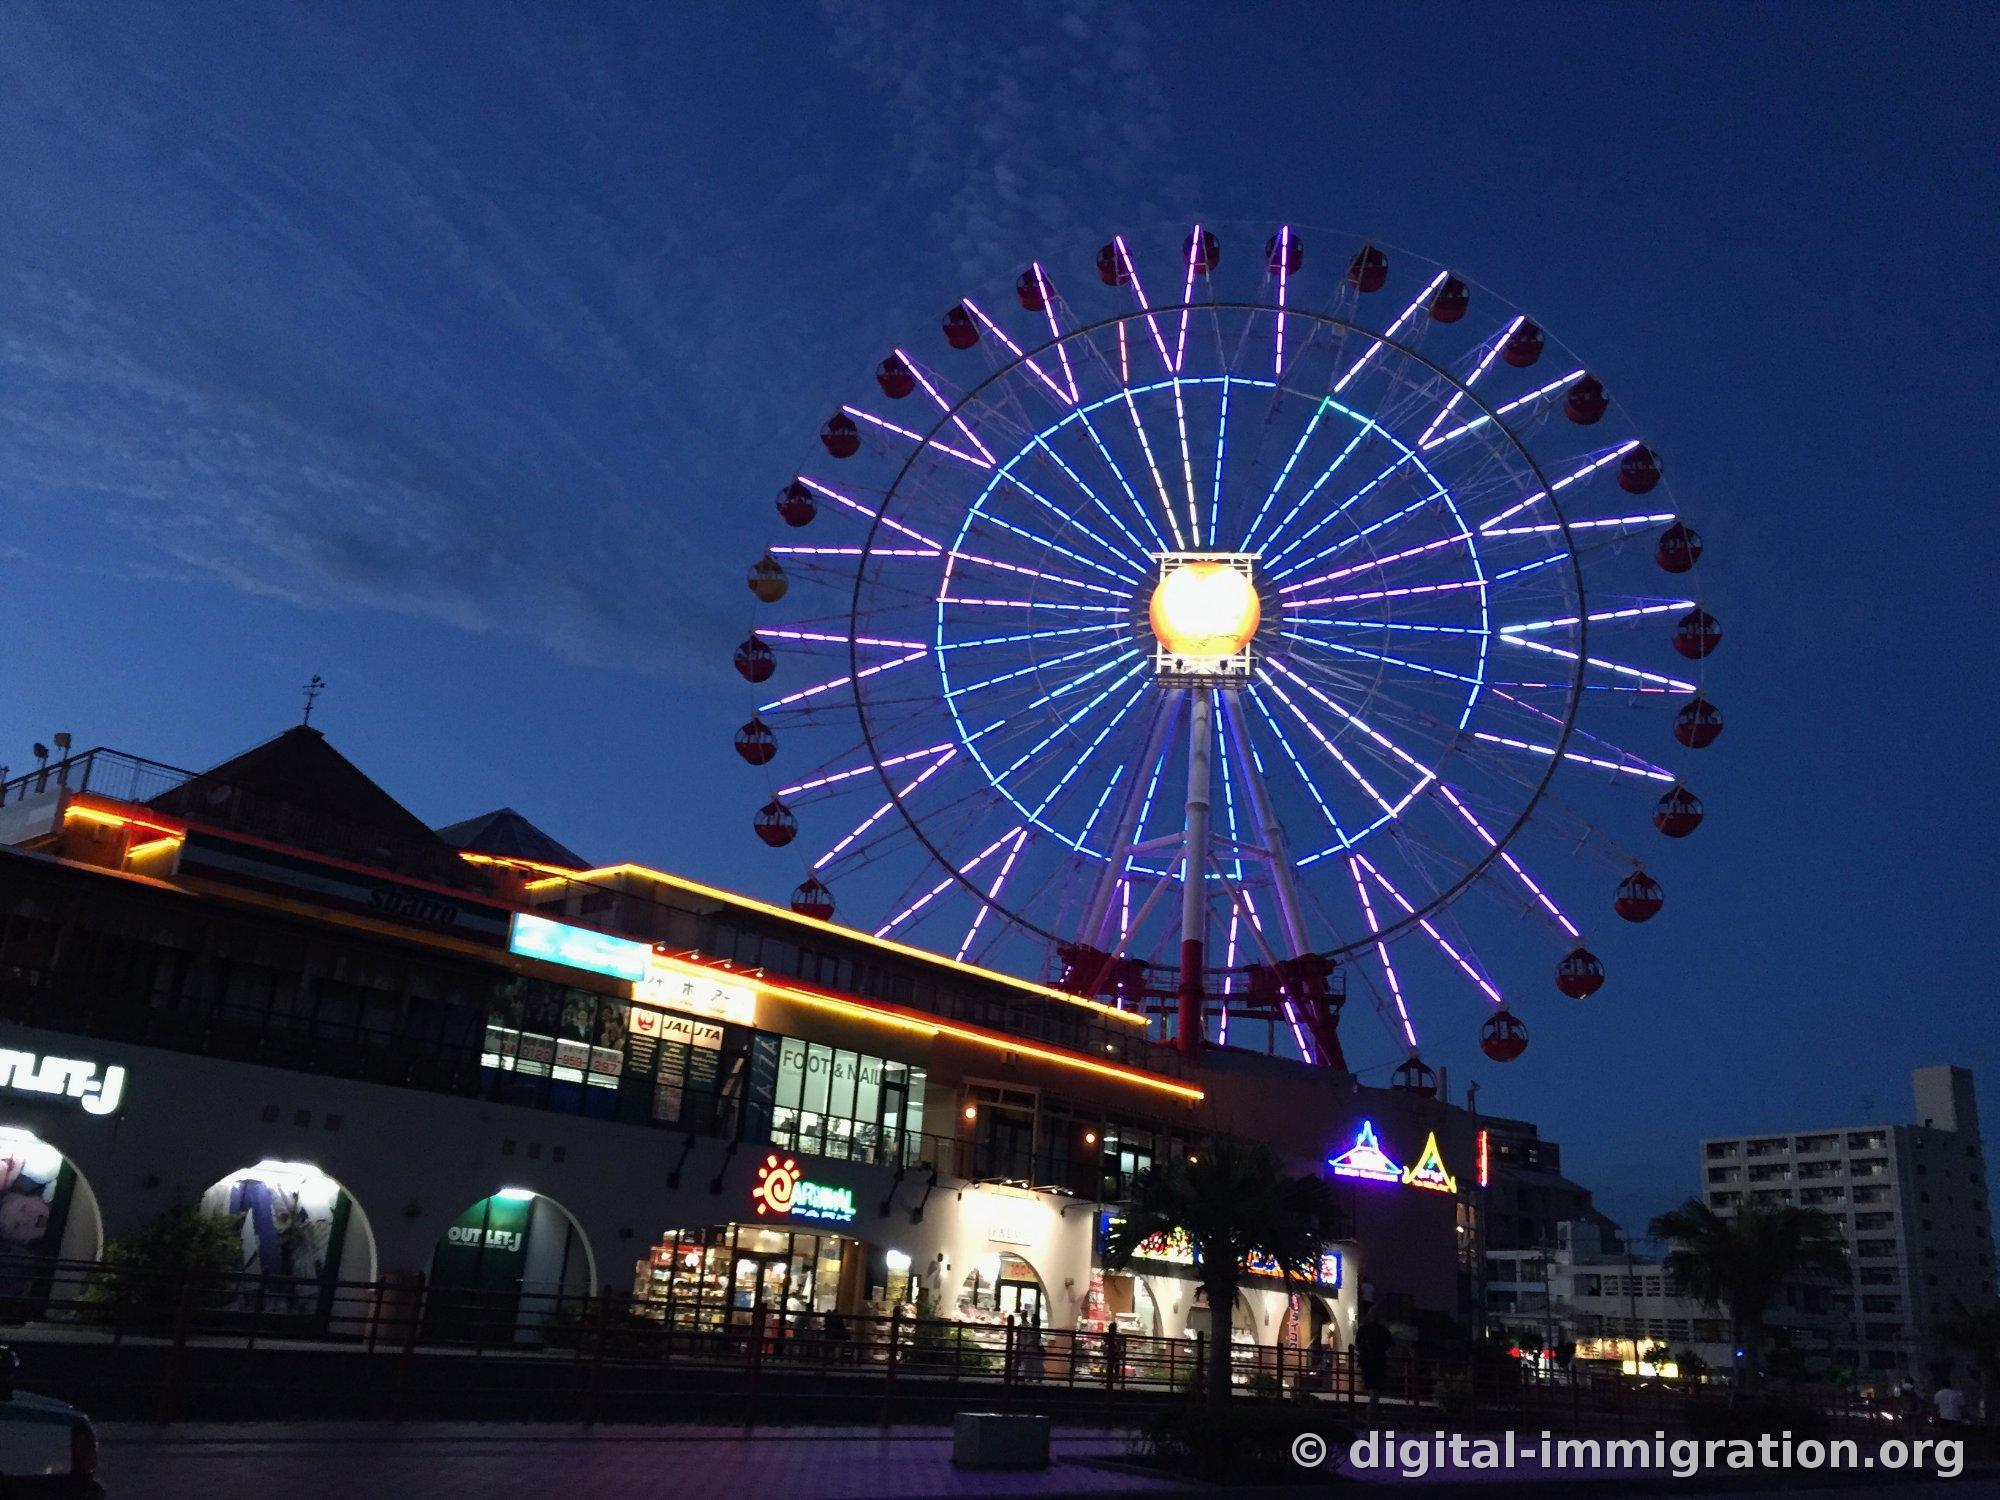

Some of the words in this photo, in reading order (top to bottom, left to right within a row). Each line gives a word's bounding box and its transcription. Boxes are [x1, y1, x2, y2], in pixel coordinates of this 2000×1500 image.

[664, 1020, 691, 1035] JAL
[693, 1028, 720, 1041] JTA
[783, 1050, 831, 1075] FOOT
[834, 1063, 843, 1079] &
